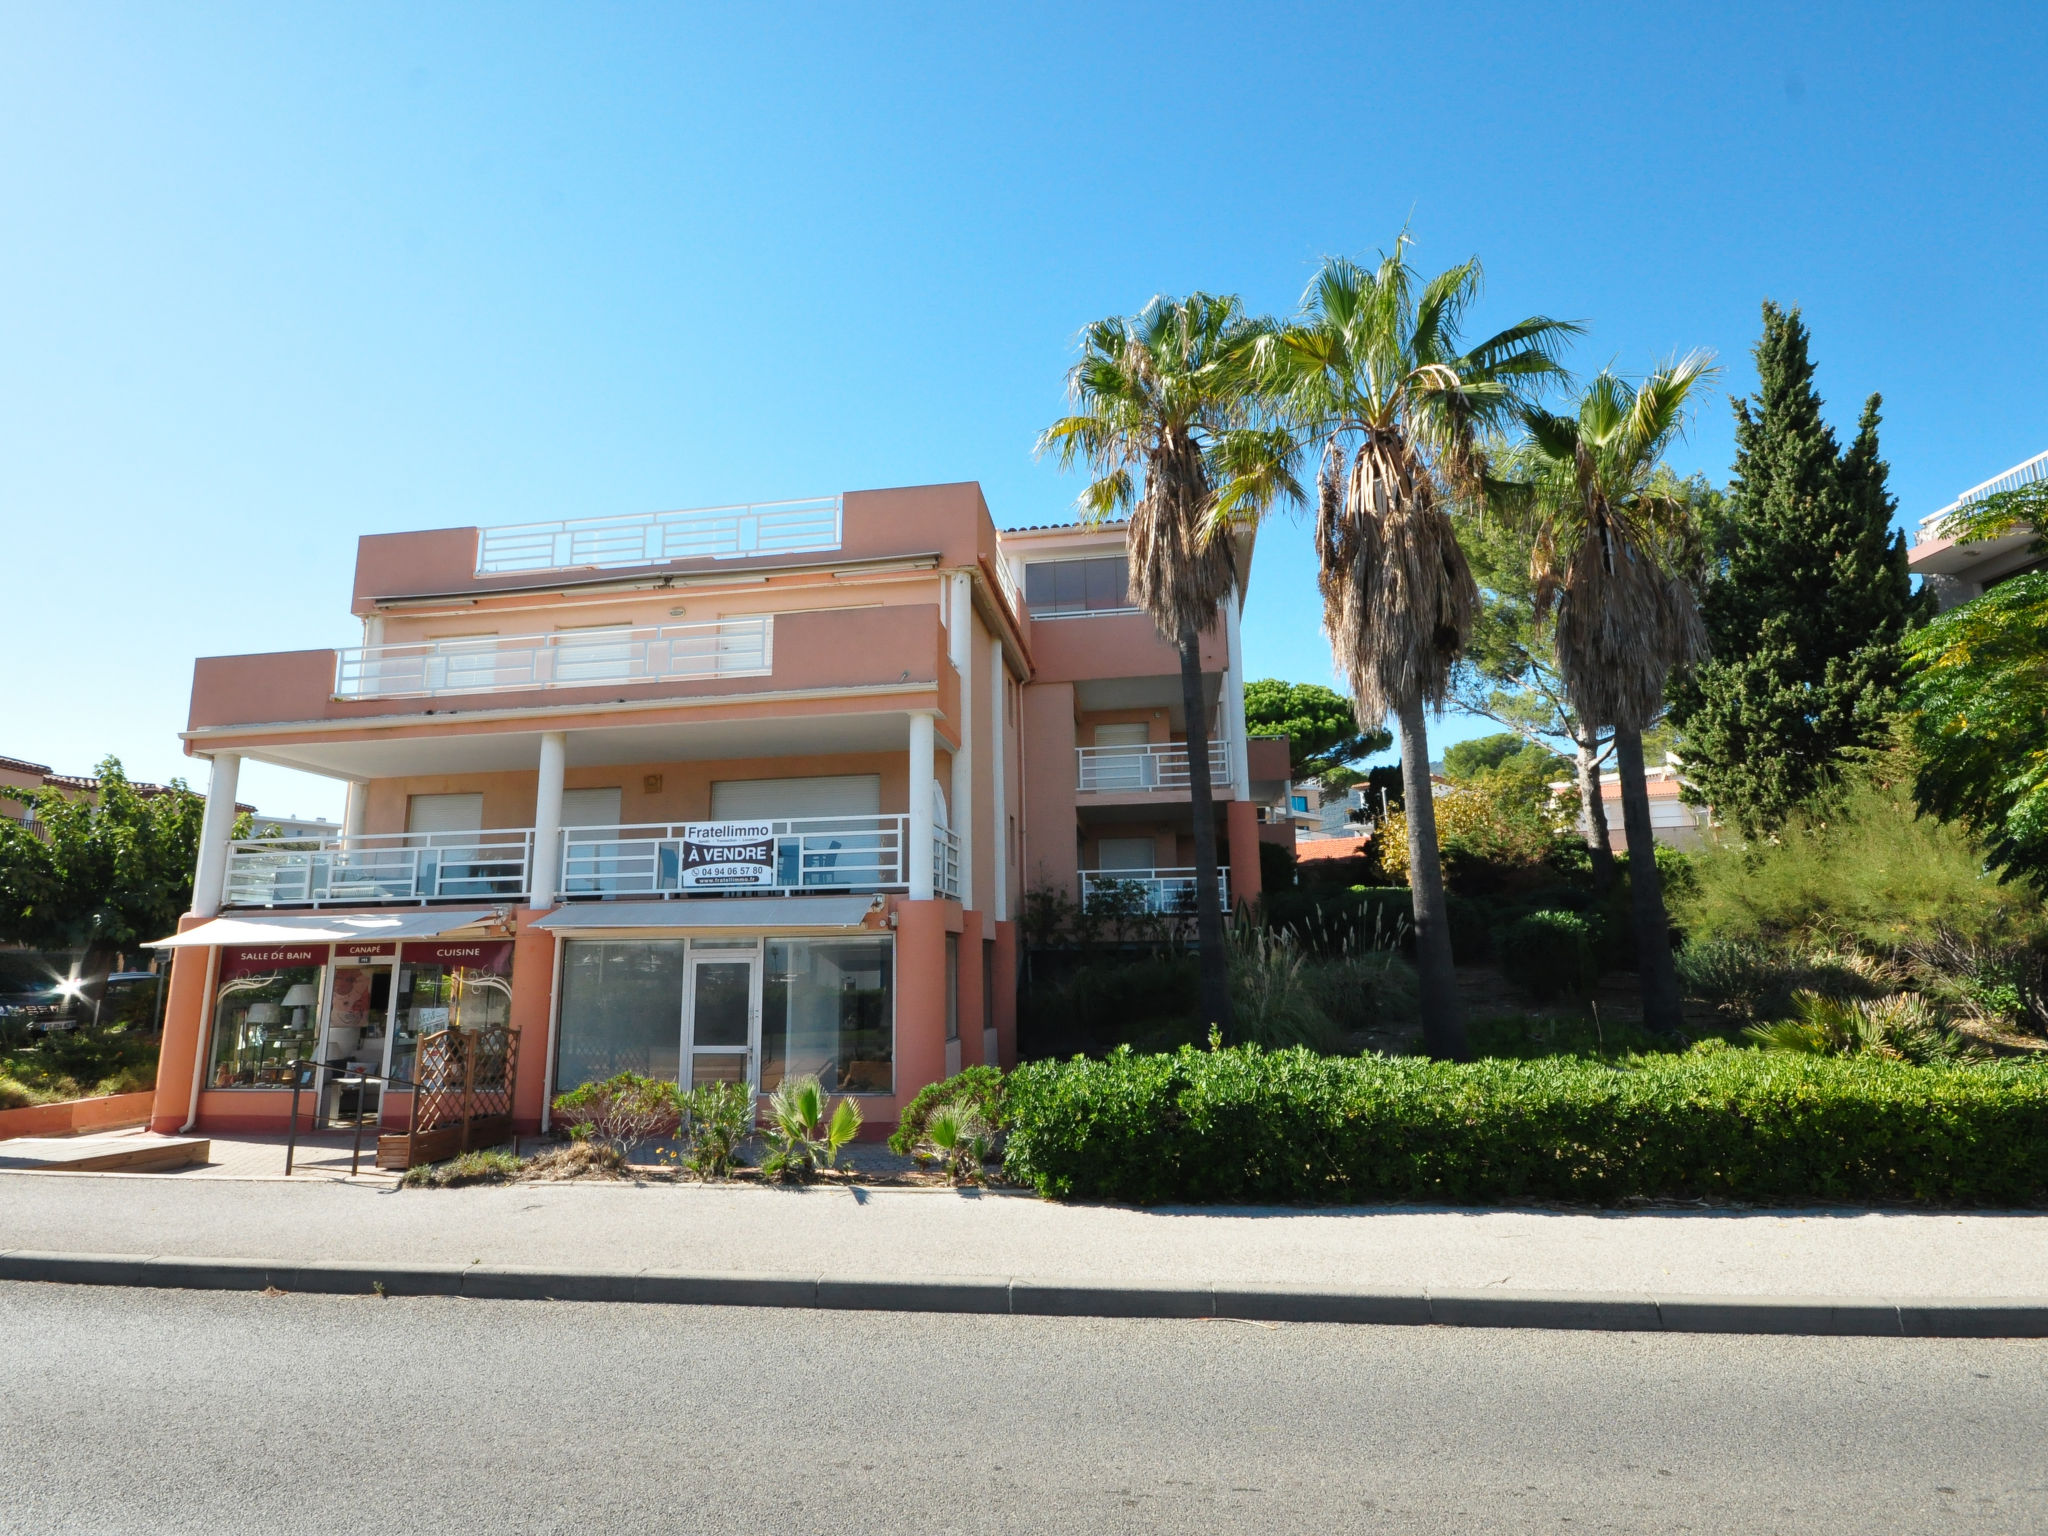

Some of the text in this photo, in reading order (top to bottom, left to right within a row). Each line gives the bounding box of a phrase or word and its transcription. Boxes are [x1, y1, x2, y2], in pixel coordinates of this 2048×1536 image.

[688, 825, 769, 838] Fratellimmo
[688, 846, 767, 862] À VENDRE
[702, 868, 712, 876] 04
[727, 867, 738, 875] 06
[752, 866, 763, 874] 80
[349, 945, 381, 954] CANAPÉ
[436, 948, 480, 957] CUISINE
[240, 952, 312, 961] SALLE DE BAIN
